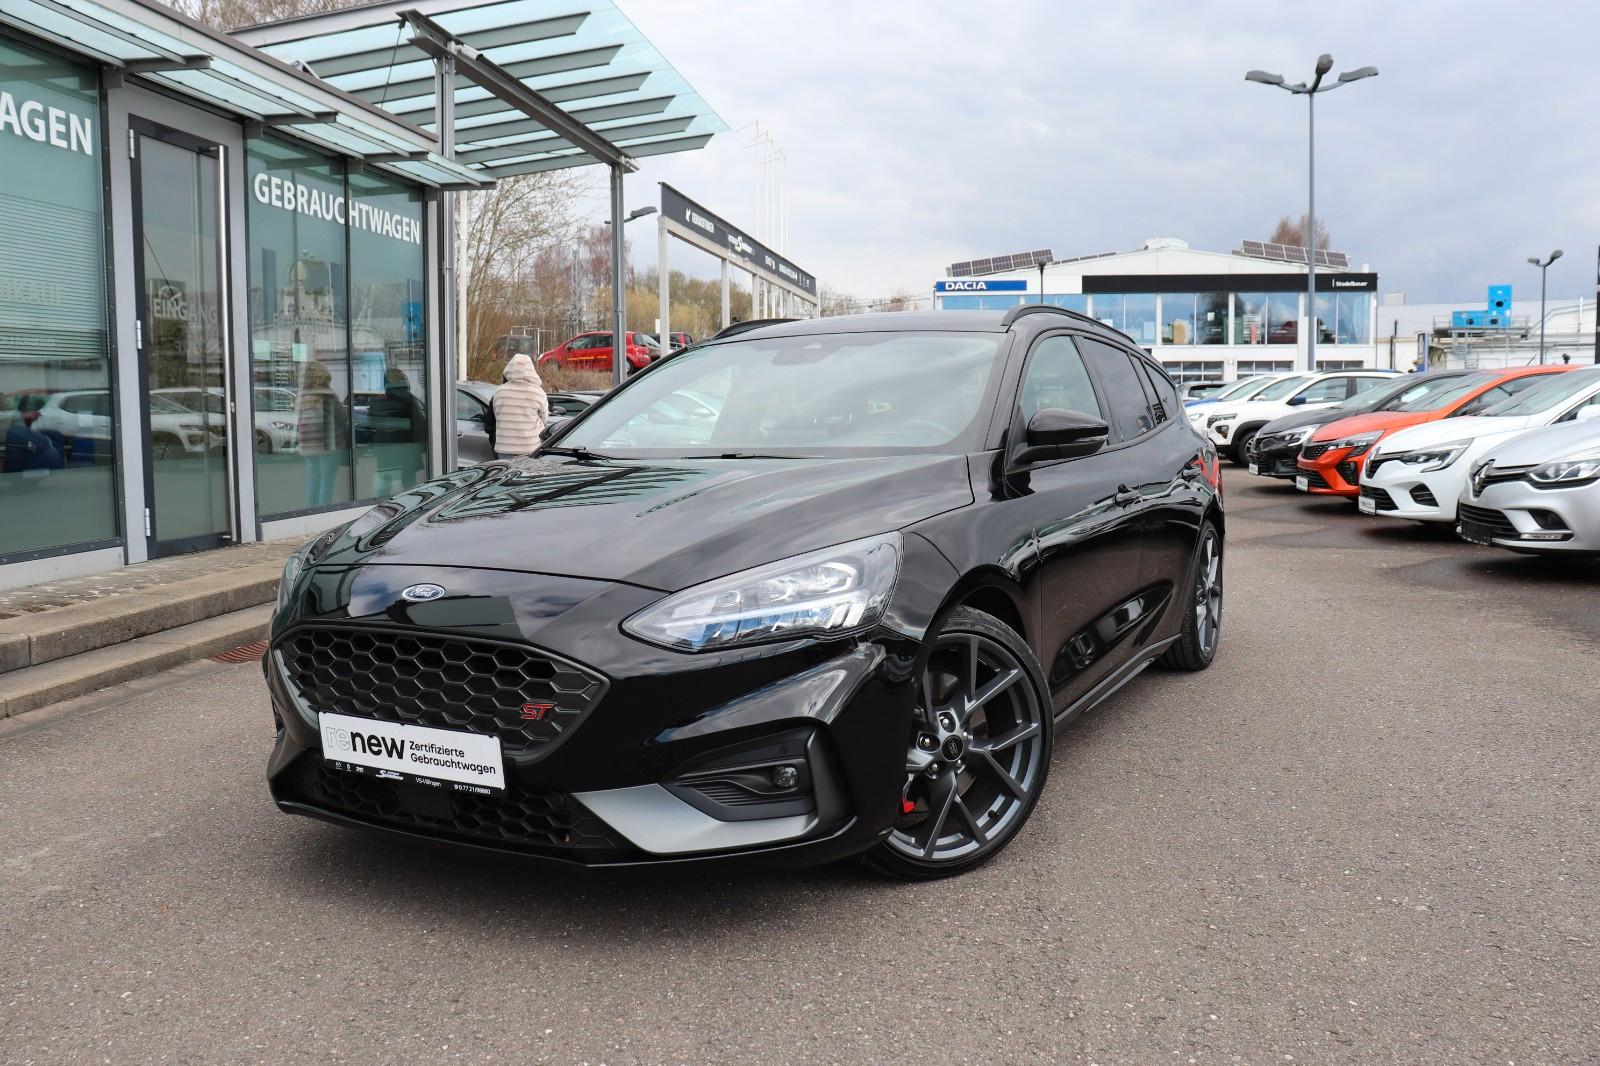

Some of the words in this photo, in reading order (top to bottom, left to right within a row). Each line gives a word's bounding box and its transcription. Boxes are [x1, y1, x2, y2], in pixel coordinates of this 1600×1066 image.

[254, 172, 420, 245] GEBRAUCHTWAGEN
[945, 281, 987, 291] DACIA
[153, 297, 217, 323] EINGANG
[521, 703, 554, 720] ST
[325, 727, 406, 760] renew
[409, 740, 465, 758] Zertifizierte
[410, 753, 496, 775] Gebrauchtwagen
